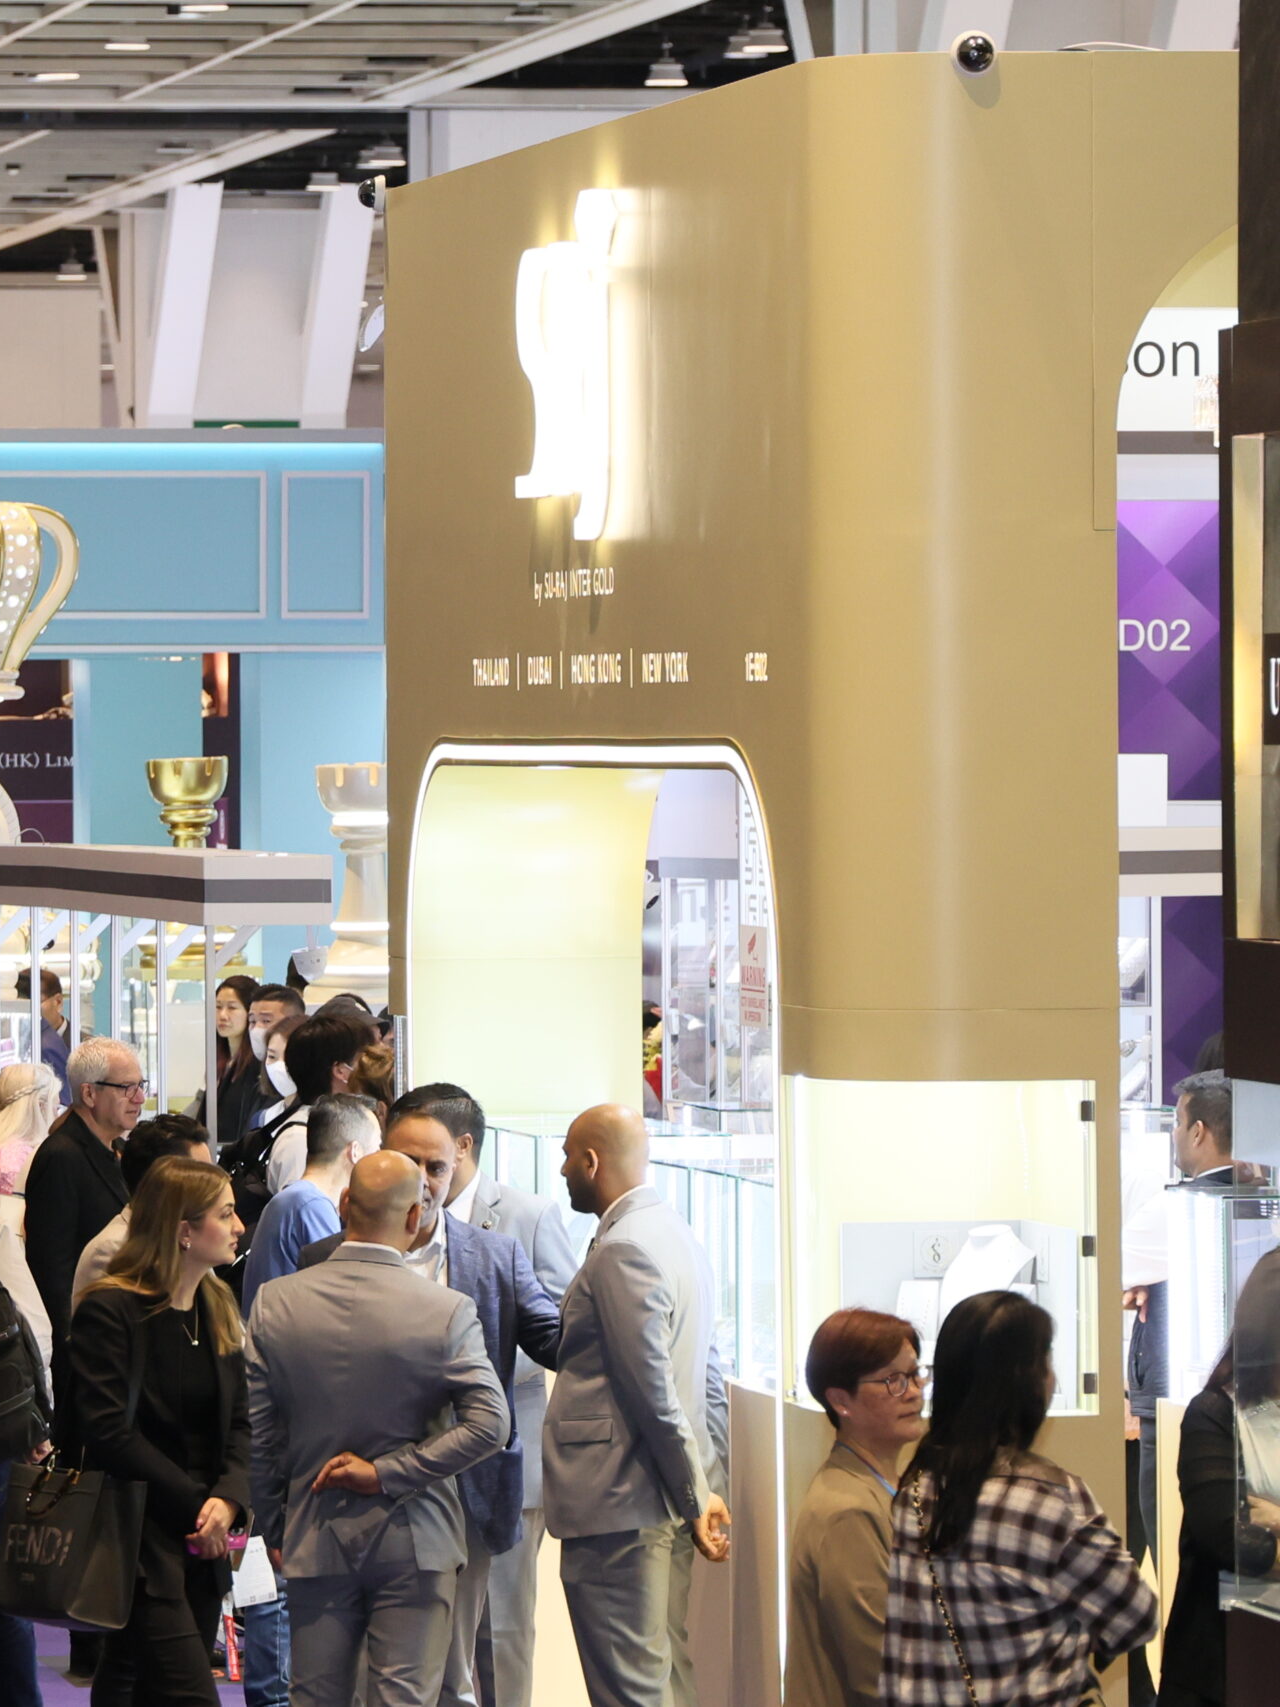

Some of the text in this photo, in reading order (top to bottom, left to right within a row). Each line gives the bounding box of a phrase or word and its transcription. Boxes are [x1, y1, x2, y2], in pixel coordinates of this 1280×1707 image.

[1124, 341, 1200, 378] on
[534, 572, 543, 607] by
[593, 567, 615, 596] GOLD
[1119, 619, 1191, 652] D02
[472, 652, 689, 686] THAILAND DUBAI HONG KONG NEW YORK
